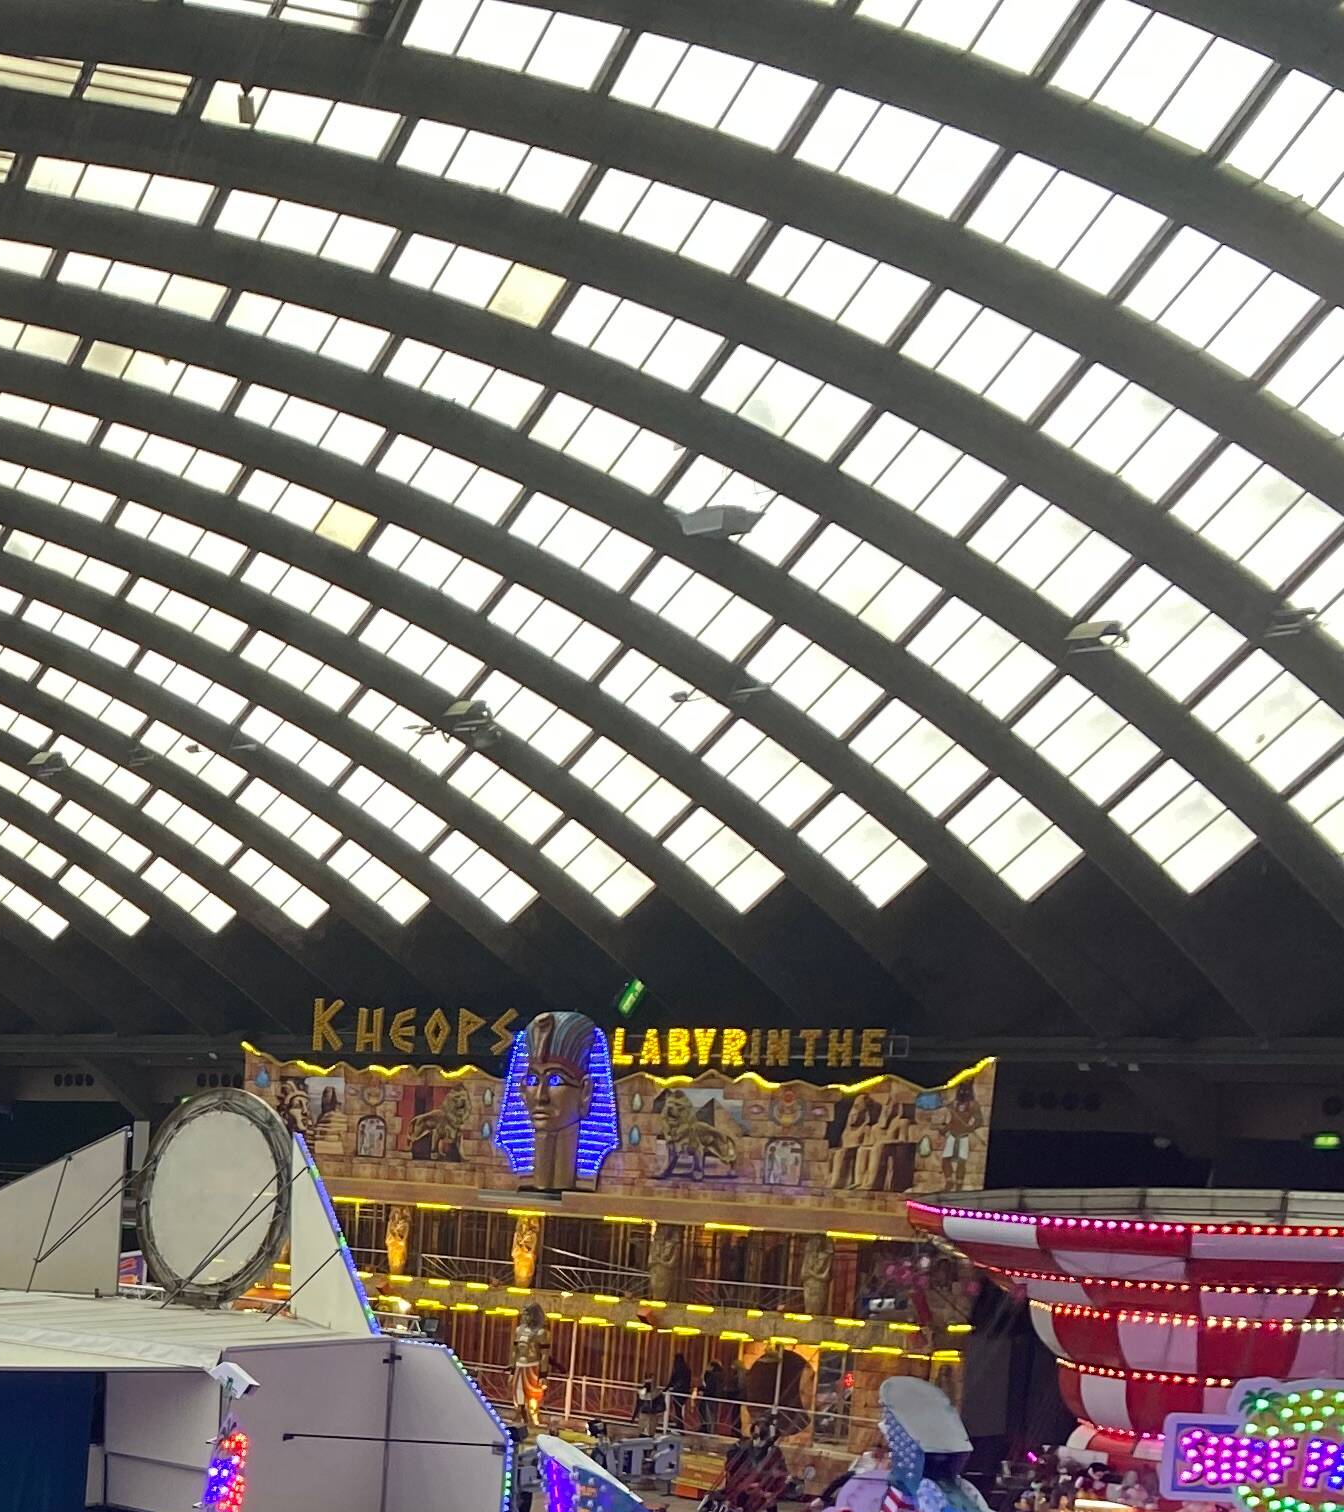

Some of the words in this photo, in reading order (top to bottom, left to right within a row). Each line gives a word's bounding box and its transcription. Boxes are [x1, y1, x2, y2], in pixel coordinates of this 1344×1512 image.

[312, 997, 519, 1054] KHEOPS
[613, 1027, 888, 1068] LABYRINTHE
[1180, 1430, 1299, 1486] SURF
